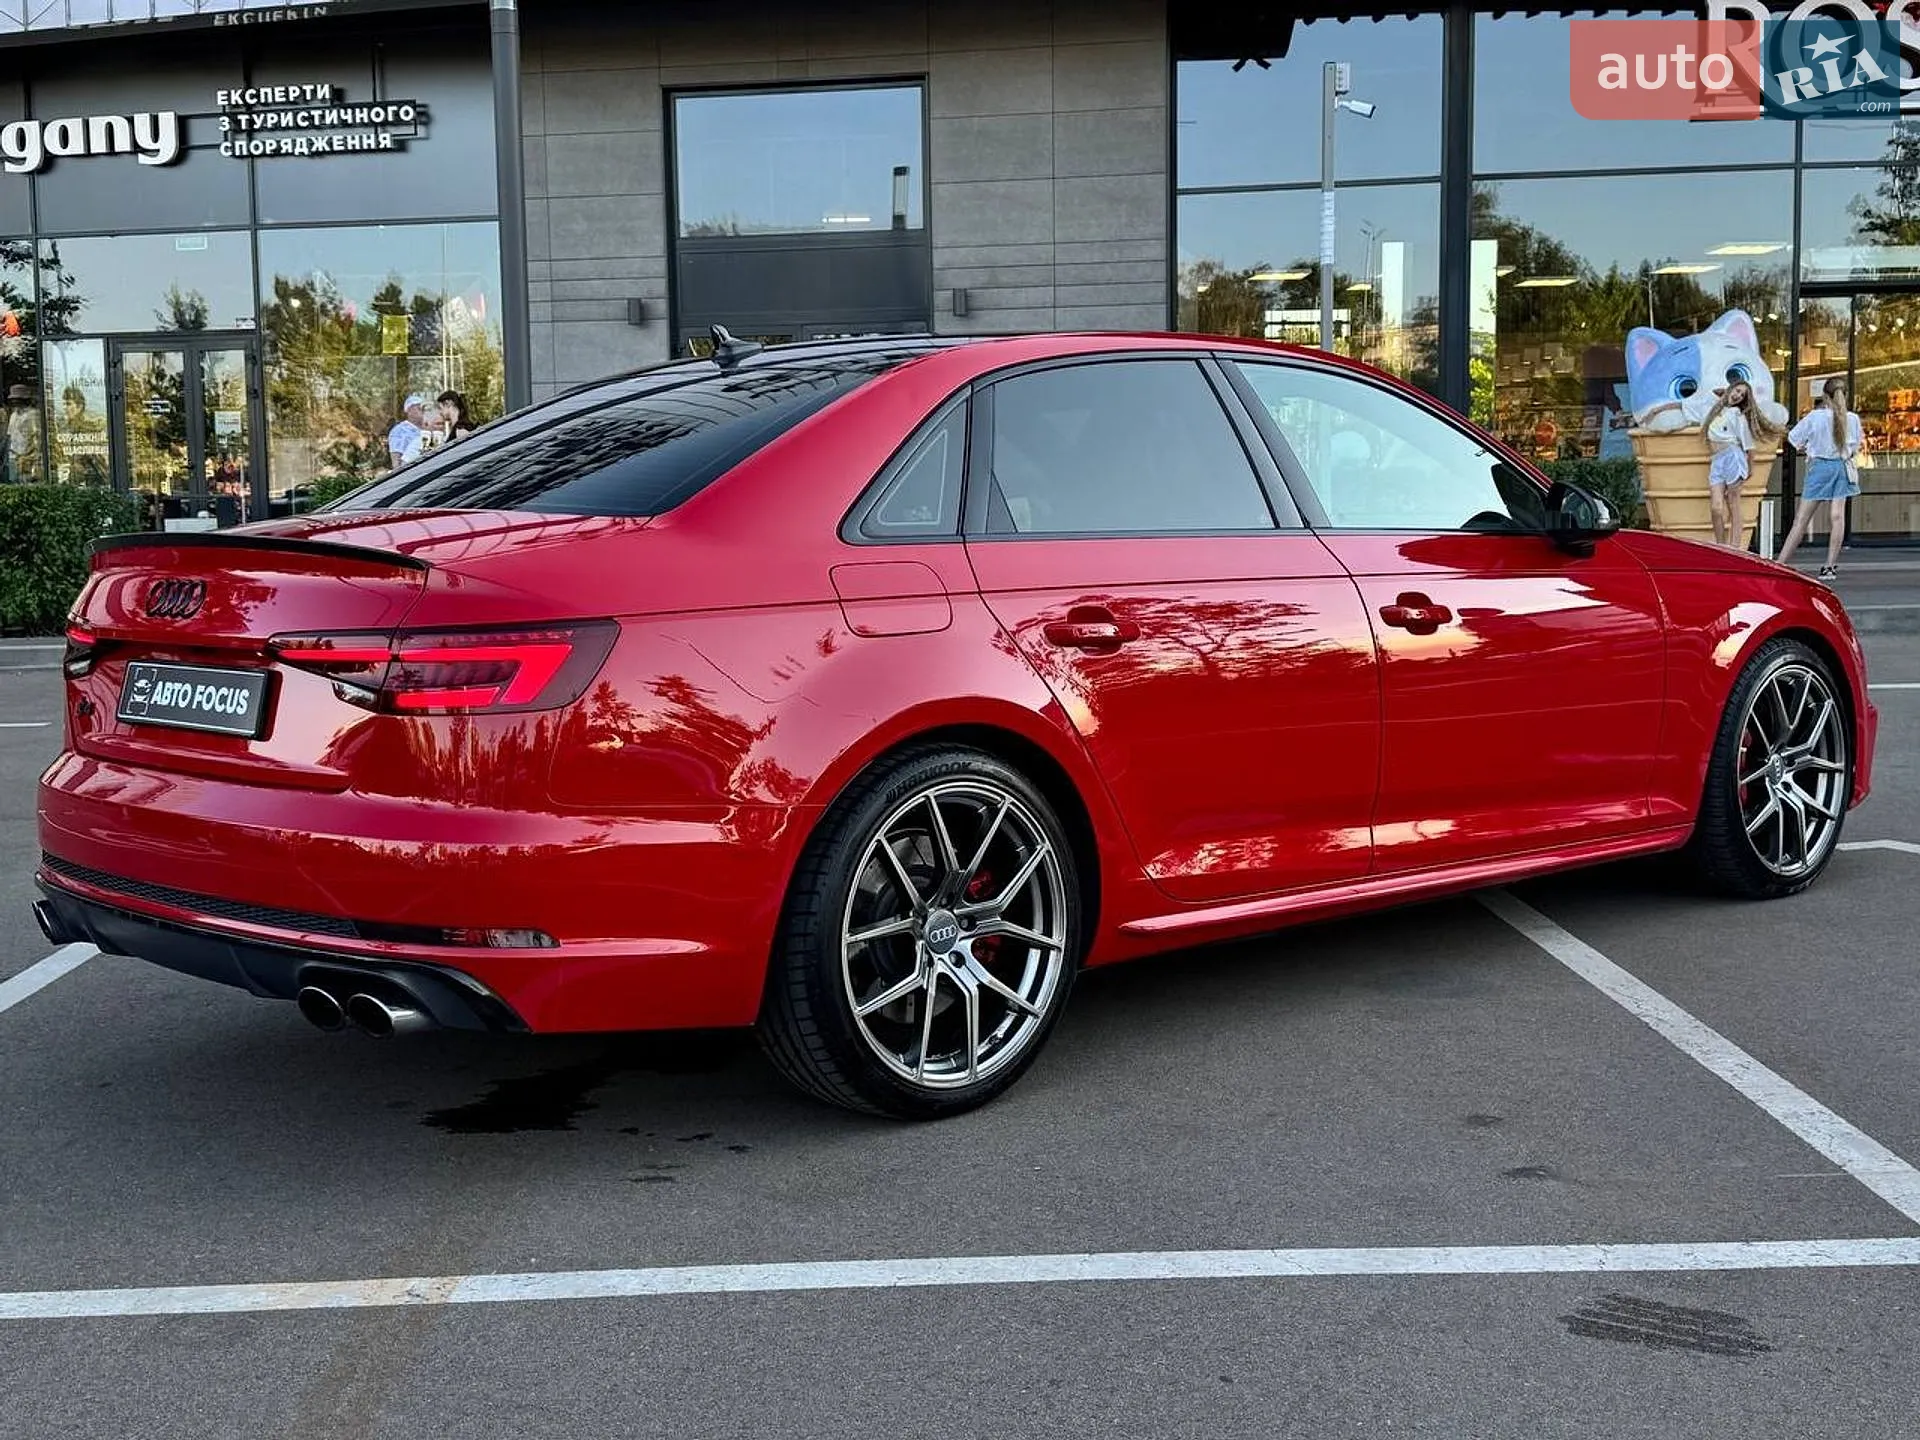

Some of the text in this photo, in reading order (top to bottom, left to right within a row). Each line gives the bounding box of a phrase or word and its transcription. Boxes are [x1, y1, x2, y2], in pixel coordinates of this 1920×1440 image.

[216, 83, 331, 106] ЕКСПЕРТИ
[237, 104, 415, 131] ТУРИСТИЧНОГО
[0, 110, 179, 174] gany
[219, 132, 393, 157] СПОРЯДЖЕННЯ
[192, 685, 250, 715] FOCUS
